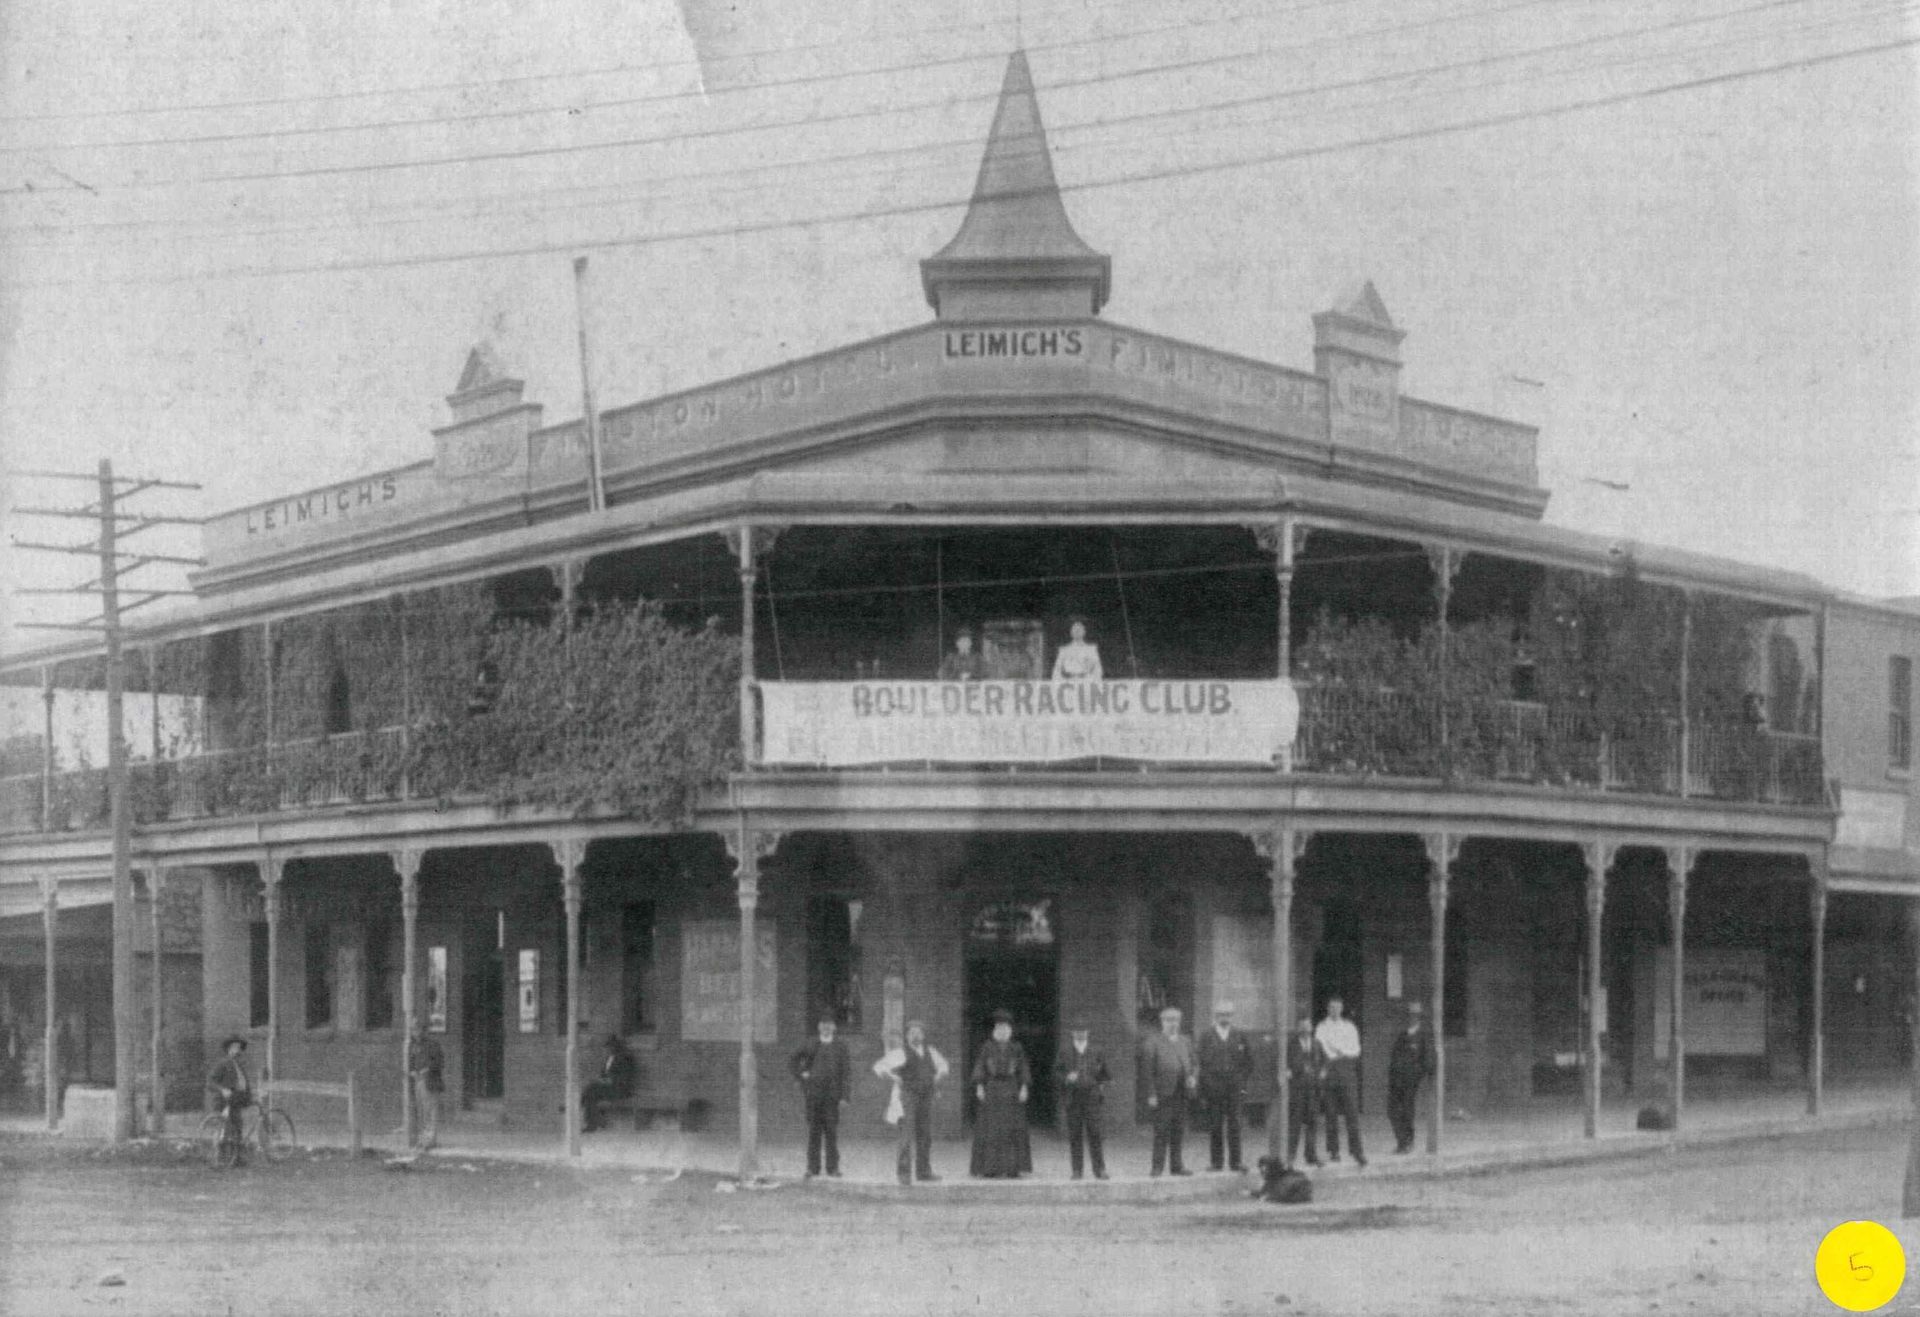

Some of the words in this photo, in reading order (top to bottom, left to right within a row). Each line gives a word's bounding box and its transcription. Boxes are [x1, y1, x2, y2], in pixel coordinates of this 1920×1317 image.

[945, 329, 1082, 357] LEIMICH'S
[852, 685, 1004, 718] BOULDER
[1013, 683, 1130, 716] RACING
